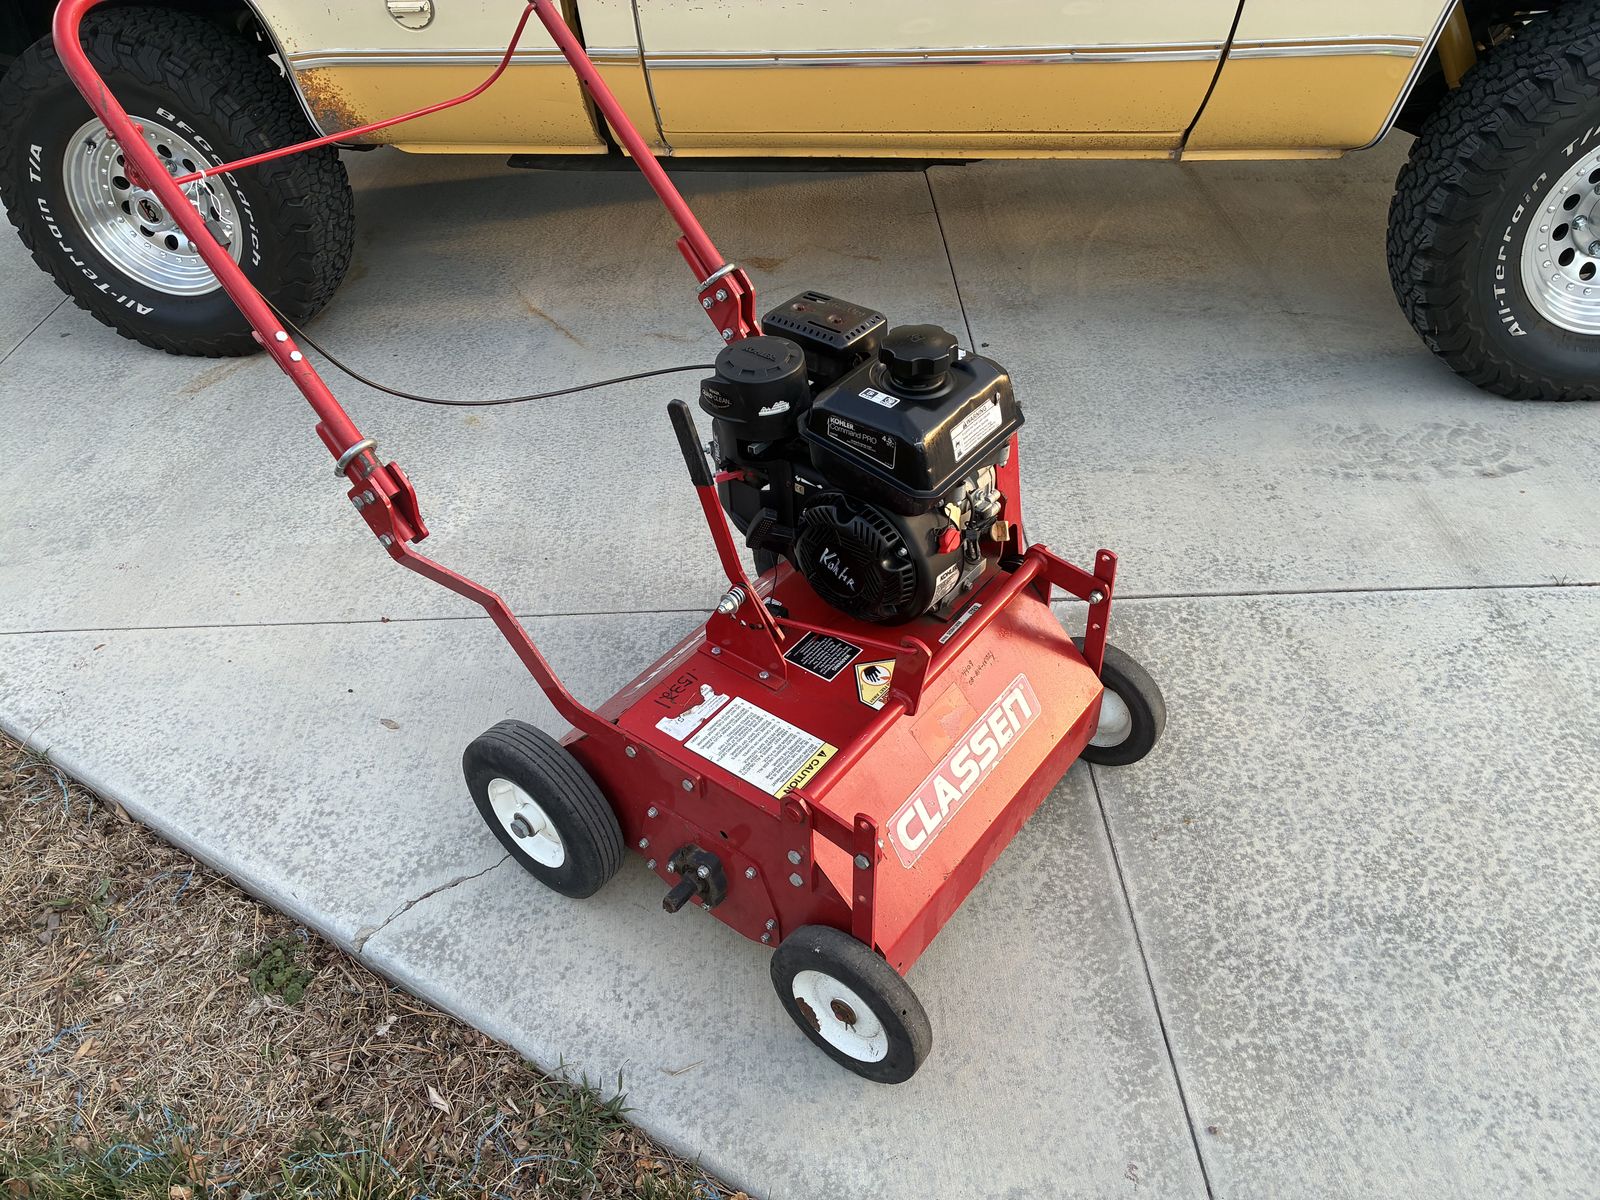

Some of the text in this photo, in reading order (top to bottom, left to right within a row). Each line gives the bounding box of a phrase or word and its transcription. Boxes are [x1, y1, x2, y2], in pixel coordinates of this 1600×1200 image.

[29, 144, 154, 315] All-Terrain T/A
[1494, 172, 1547, 337] All-Terrain
[830, 417, 855, 431] KOHLER
[830, 422, 877, 444] Command PRO
[783, 759, 820, 794] CAUTION
[896, 688, 1033, 851] CLASSEN
